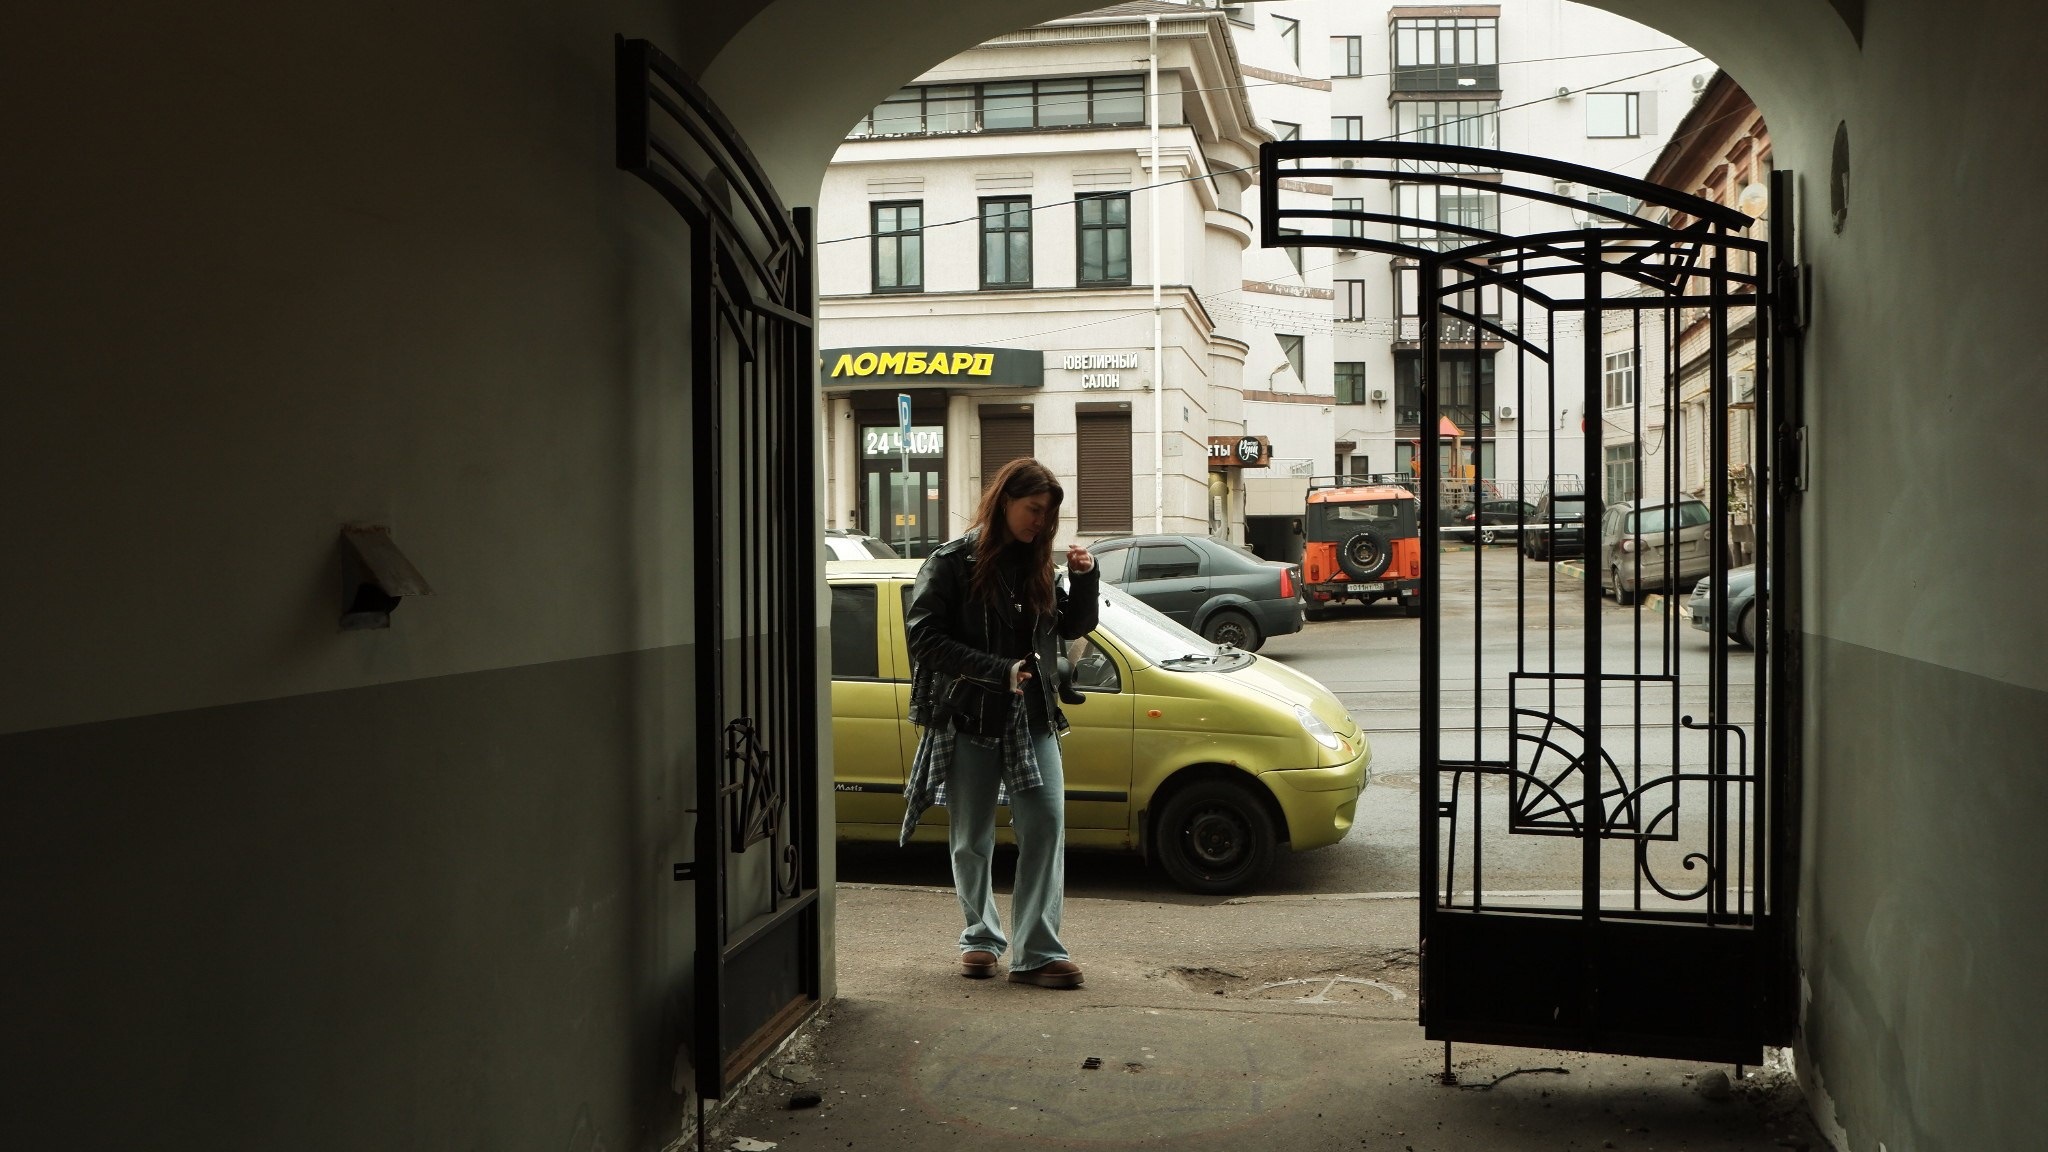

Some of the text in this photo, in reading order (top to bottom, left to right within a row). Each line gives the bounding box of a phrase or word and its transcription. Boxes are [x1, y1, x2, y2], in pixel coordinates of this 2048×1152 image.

[831, 351, 995, 378] ЛОМБАРД
[1063, 352, 1138, 370] ЮВЕЛИРНЫЙ
[1081, 373, 1120, 389] САЛОН
[867, 431, 940, 455] 24 ЧАСА
[834, 783, 863, 791] Matiz
